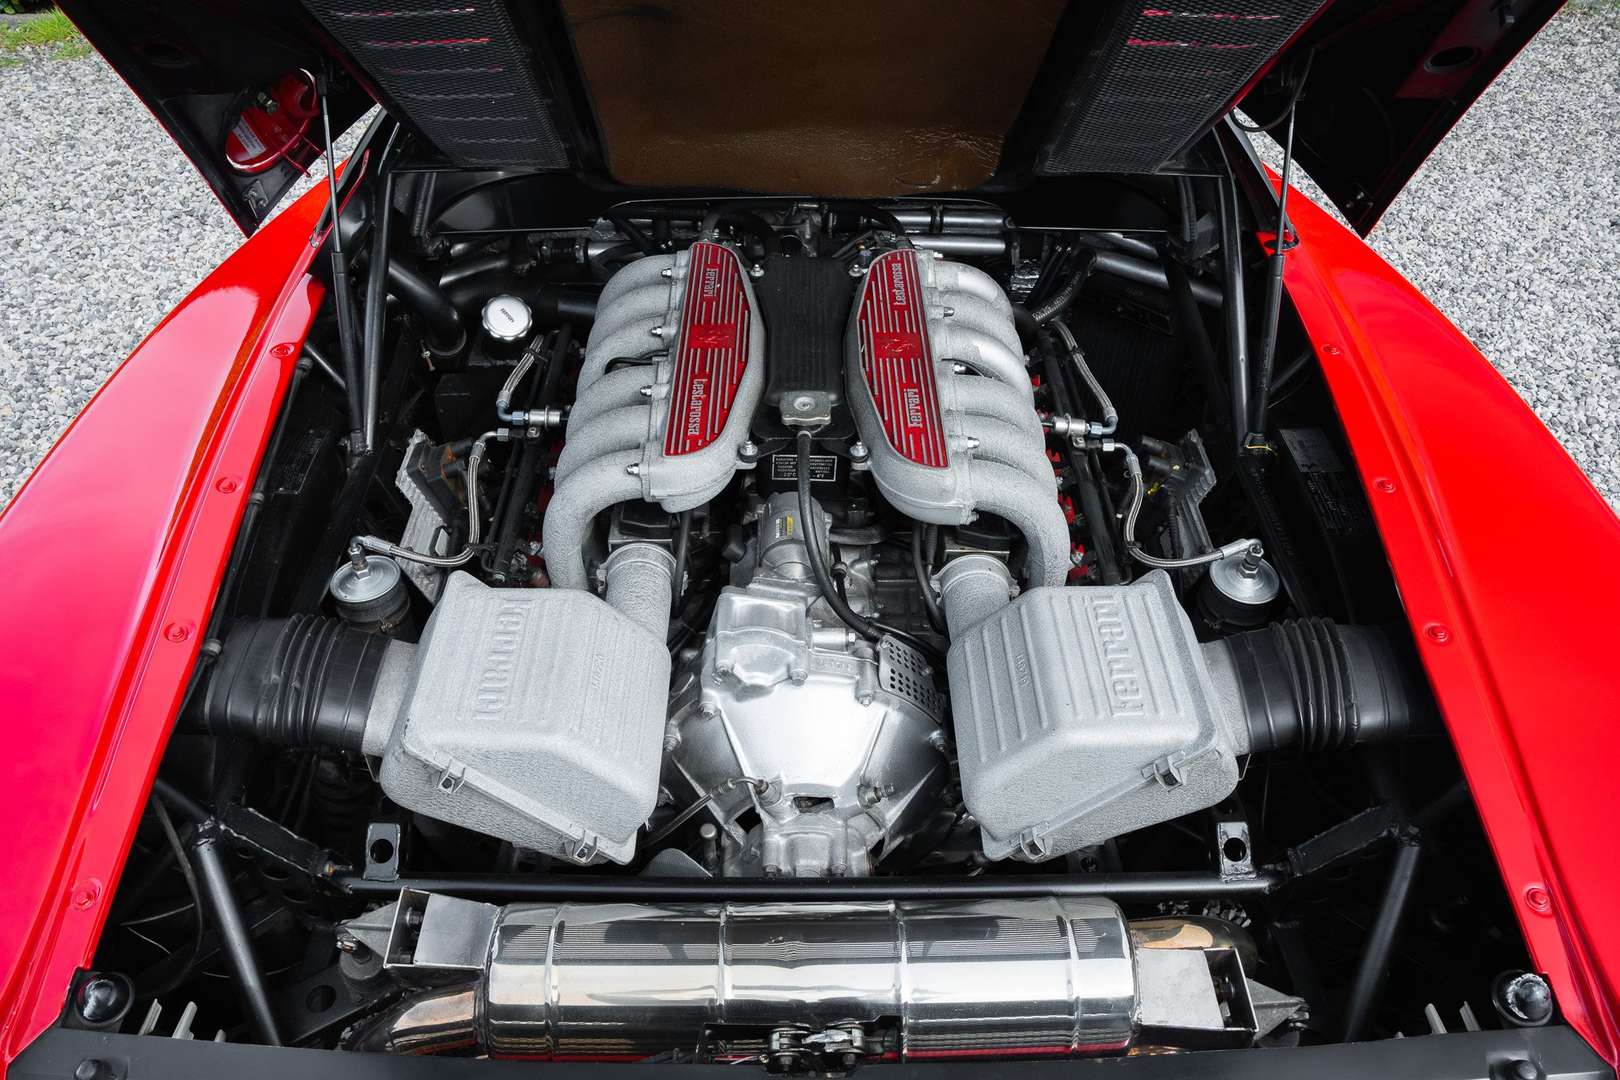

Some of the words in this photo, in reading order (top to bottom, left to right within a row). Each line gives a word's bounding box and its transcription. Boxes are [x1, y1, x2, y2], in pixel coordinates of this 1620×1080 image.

[704, 268, 718, 297] Ferrari
[904, 388, 923, 428] Ferrari
[473, 599, 532, 721] Ferrari
[1090, 595, 1145, 717] Ferrari
